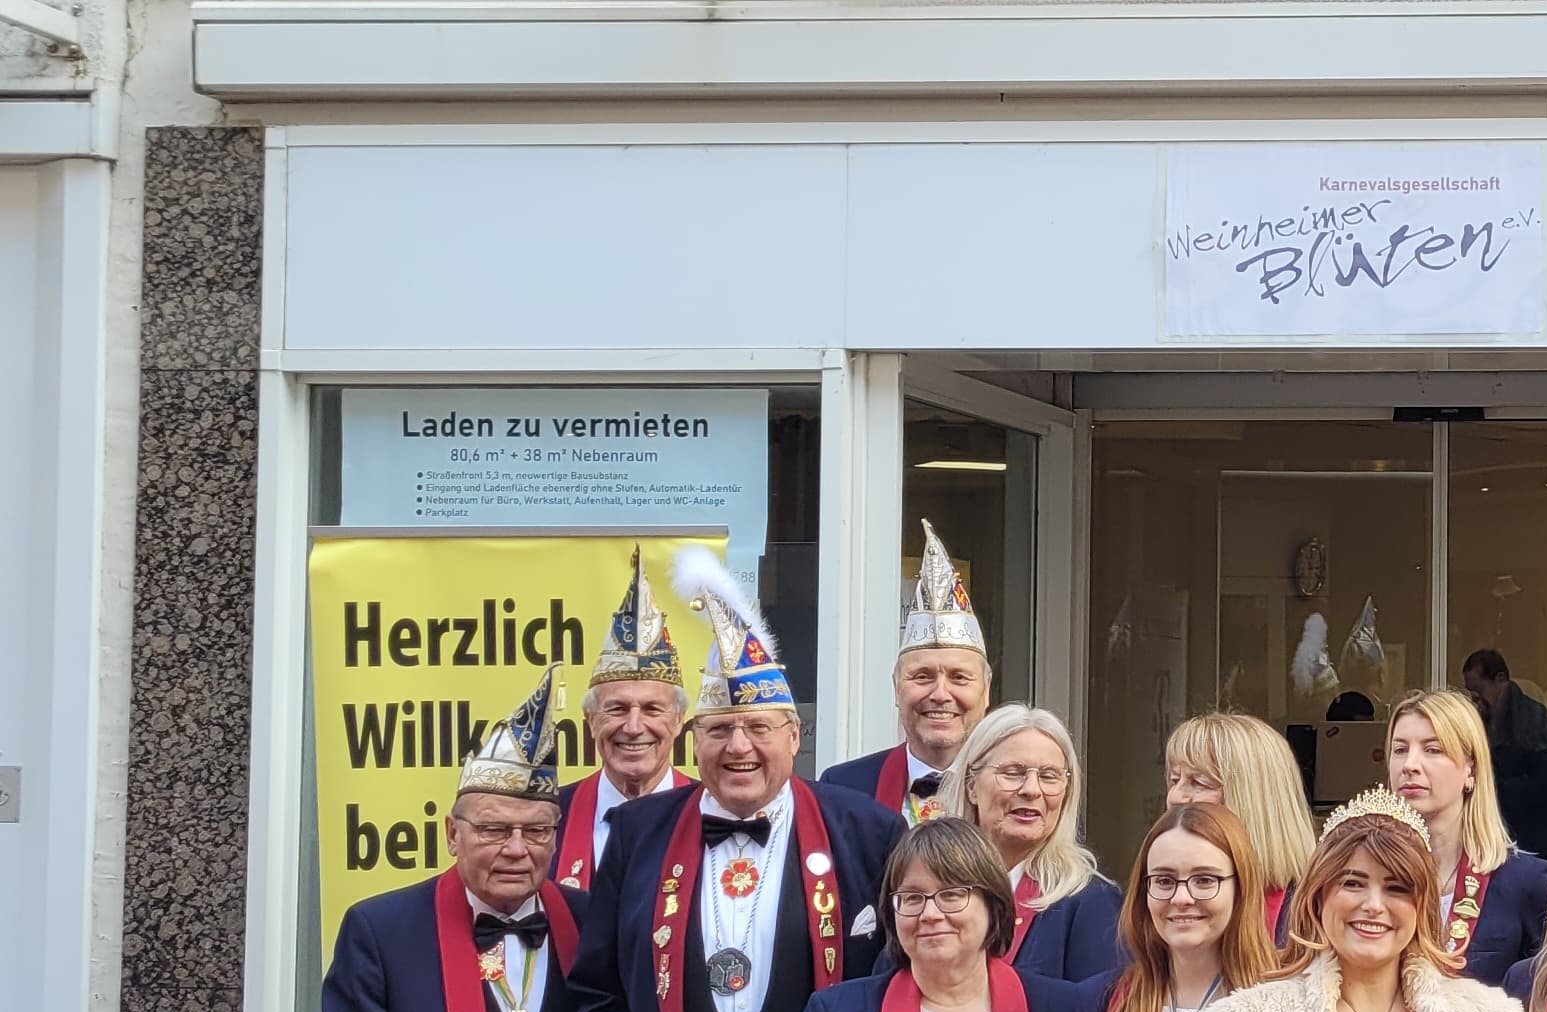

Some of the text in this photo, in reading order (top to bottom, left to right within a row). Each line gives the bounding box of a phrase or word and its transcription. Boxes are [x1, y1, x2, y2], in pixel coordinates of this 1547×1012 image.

[1319, 176, 1501, 194] Karnevalsgesellschaft
[1167, 199, 1542, 304] Weinheimer Blüten e.V.
[402, 410, 709, 438] Laden zu vermieten
[450, 449, 480, 464] 80,6
[485, 449, 505, 462] m²
[523, 449, 542, 462] 38
[547, 449, 567, 462] m²
[571, 449, 658, 463] Nebenraum
[425, 471, 483, 480] Straßenfront
[515, 471, 568, 482] neuwertige
[571, 472, 629, 481] Bausubstanz
[425, 483, 743, 495] Eingang und Ladenfläche ebenerdig ohne Stufen, Automatik-Ladentür
[425, 496, 726, 508] Nebenraum für Büro, Werkstatt, Aufenthalt, Lager und WC-Anlage
[425, 508, 469, 518] Parkplatz
[343, 597, 585, 667] Herzlich
[342, 699, 700, 769] Willkn
[345, 800, 439, 871] bei
